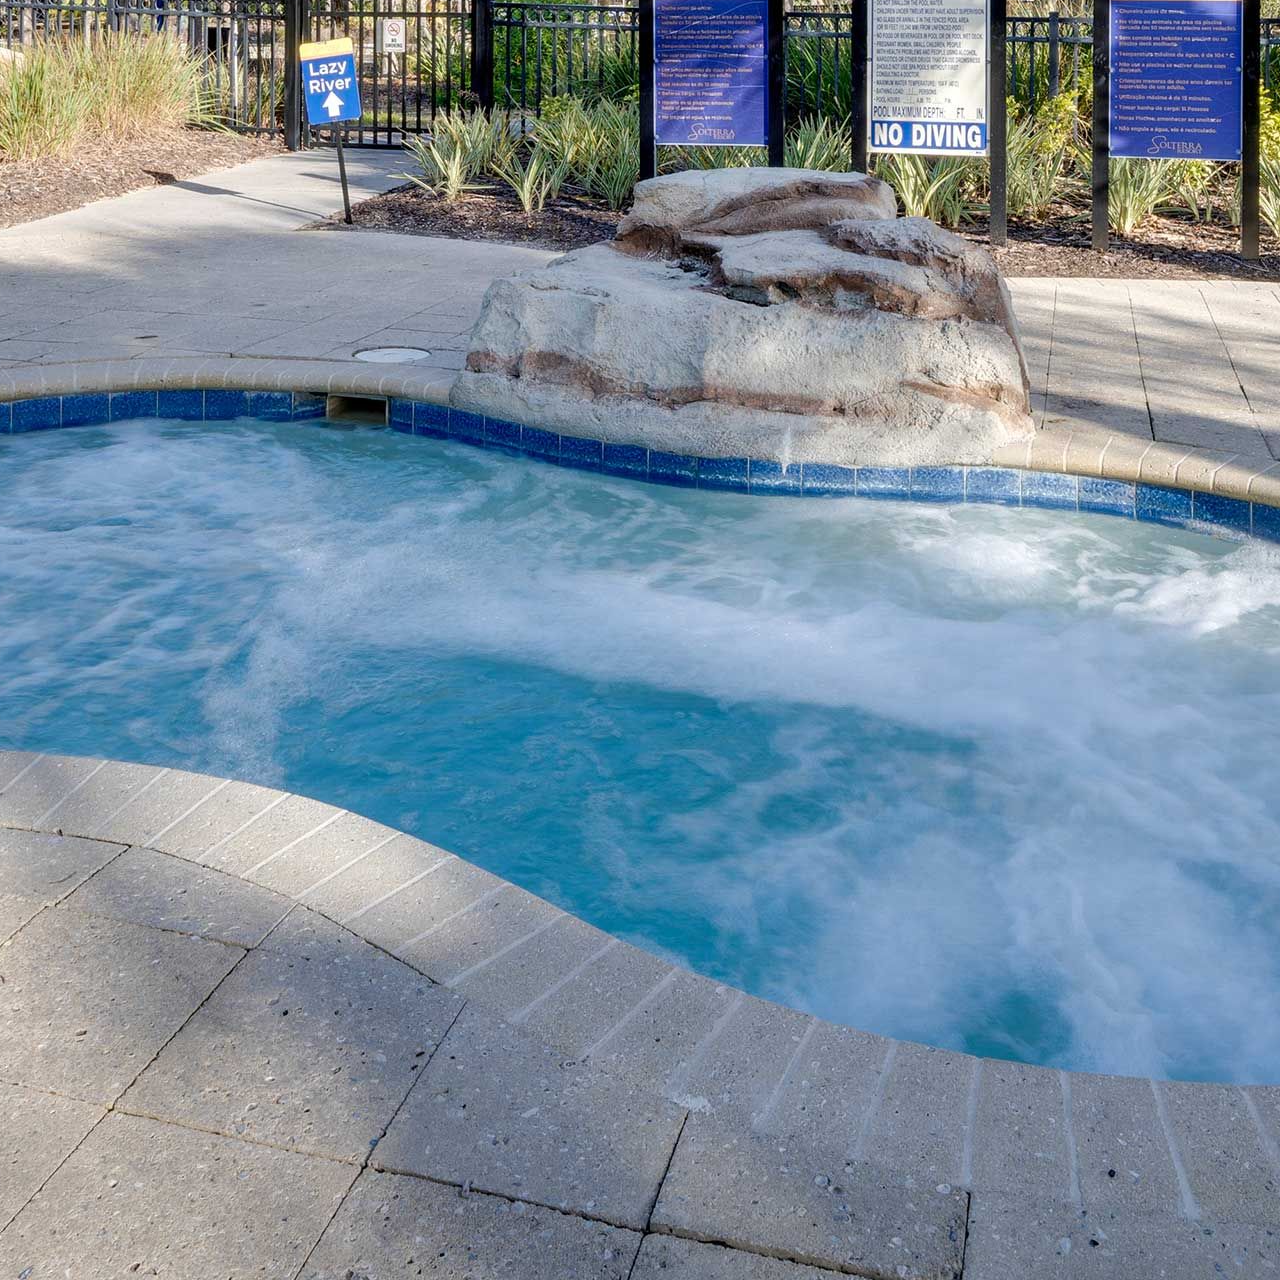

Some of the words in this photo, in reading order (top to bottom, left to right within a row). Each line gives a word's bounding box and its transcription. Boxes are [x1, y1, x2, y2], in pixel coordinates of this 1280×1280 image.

[309, 61, 347, 76] Lazy
[309, 78, 352, 94] River
[874, 106, 890, 117] POOL
[892, 106, 922, 118] MAXIMUM
[874, 123, 903, 146] NO
[912, 124, 981, 148] DIVING
[1147, 135, 1202, 153] SOLTERRA
